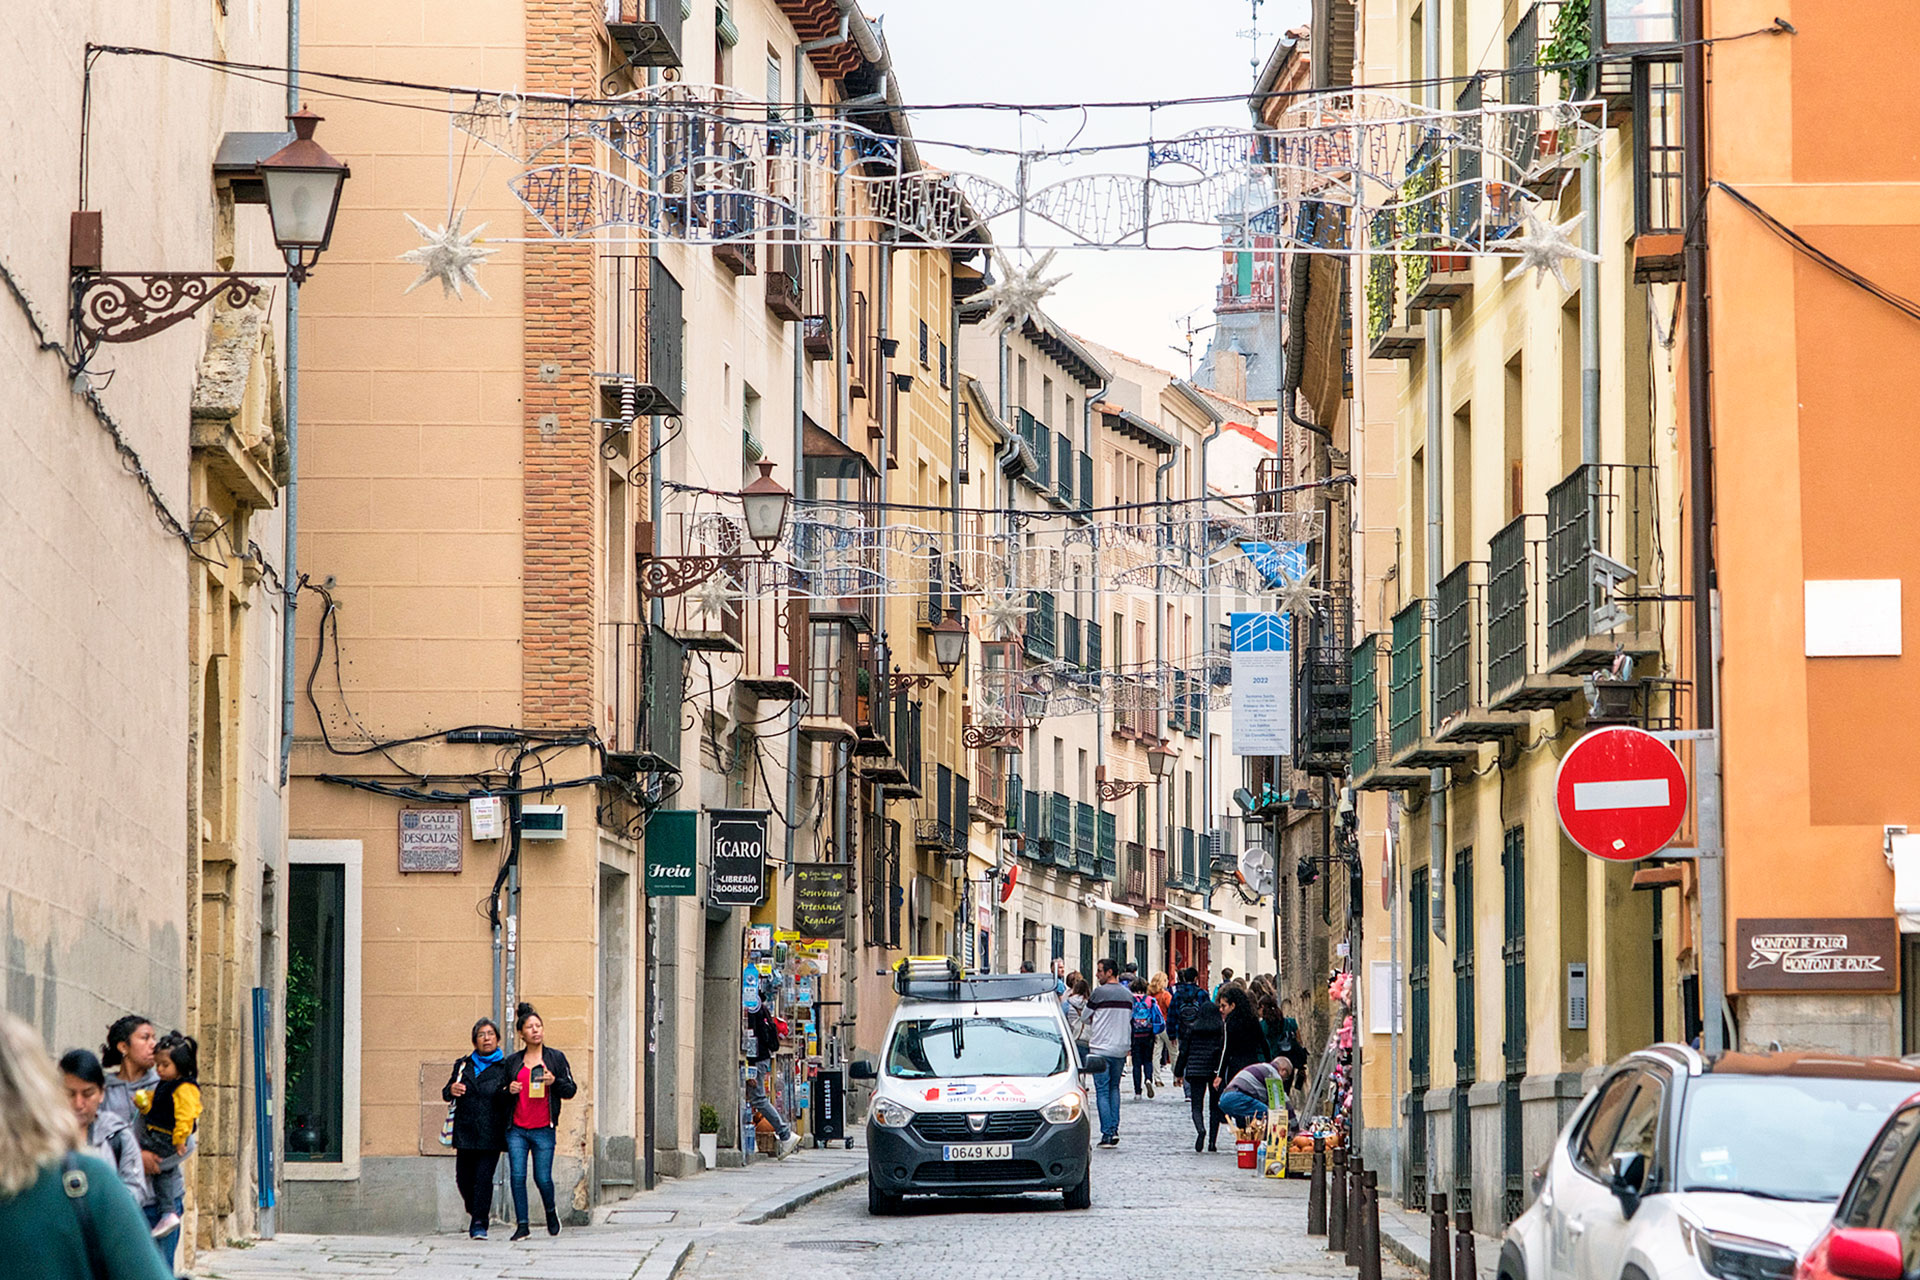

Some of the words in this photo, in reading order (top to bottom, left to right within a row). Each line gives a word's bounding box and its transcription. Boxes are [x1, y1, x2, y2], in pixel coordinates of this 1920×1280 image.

[422, 814, 455, 824] CALLE
[404, 832, 458, 844] DESCALZAS
[716, 837, 761, 858] ÍCARO
[716, 884, 760, 894] BOOKSHOP
[800, 887, 841, 898] Souvenir
[797, 901, 843, 912] Artesanía
[803, 914, 836, 930] Regalos
[1754, 937, 1799, 949] MONTON
[1800, 936, 1811, 949] DE
[1812, 935, 1847, 950] TRIGO
[1785, 958, 1831, 970] MONTON
[1833, 958, 1844, 970] DE
[823, 1080, 832, 1119] SOUVENIRS
[951, 1147, 982, 1158] 0649
[986, 1145, 1010, 1158] KJJ
